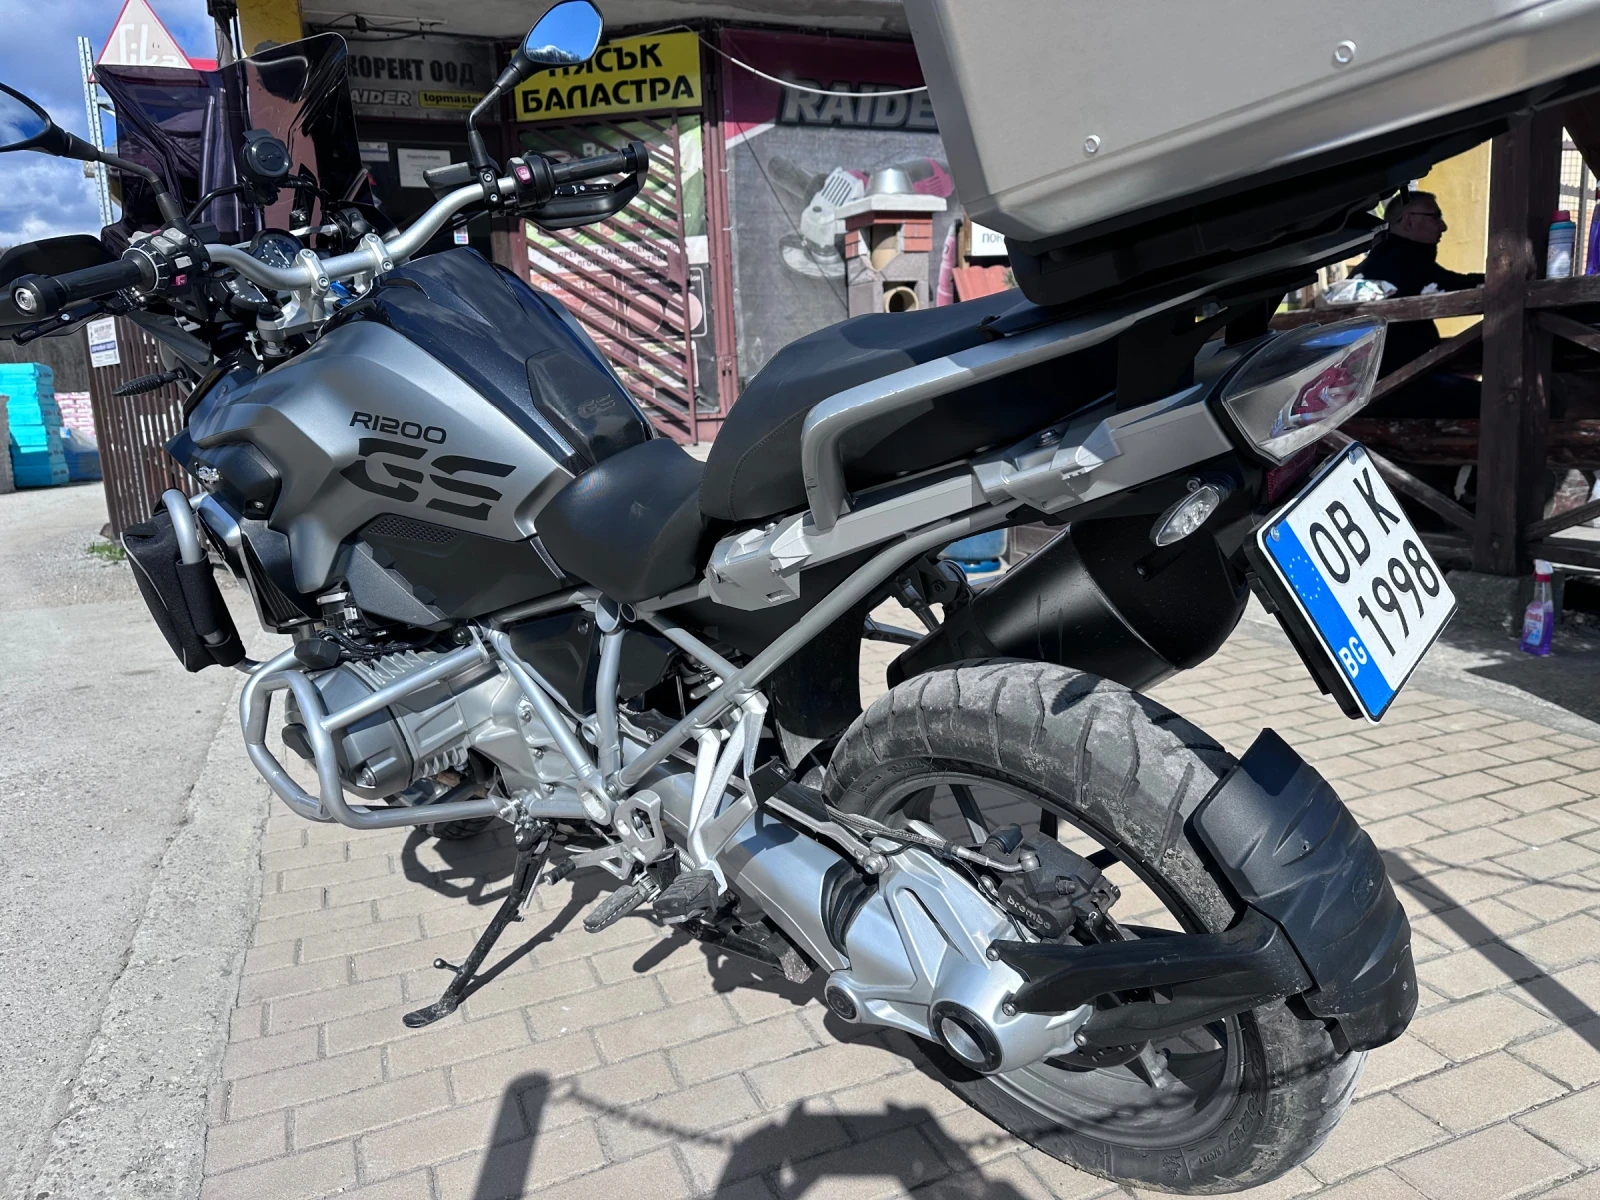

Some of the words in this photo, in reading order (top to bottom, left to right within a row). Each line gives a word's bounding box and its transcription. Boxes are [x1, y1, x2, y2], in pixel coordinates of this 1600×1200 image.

[347, 54, 424, 82] КОРЕКТ
[429, 60, 476, 87] ООД
[521, 75, 695, 114] БАЛАСТРА
[349, 411, 447, 445] R1200
[339, 437, 517, 521] GS
[1309, 500, 1371, 584] OB
[1352, 467, 1401, 536] K
[1357, 539, 1440, 657] 1998
[1338, 636, 1368, 679] BG
[1007, 894, 1051, 930] brembo
